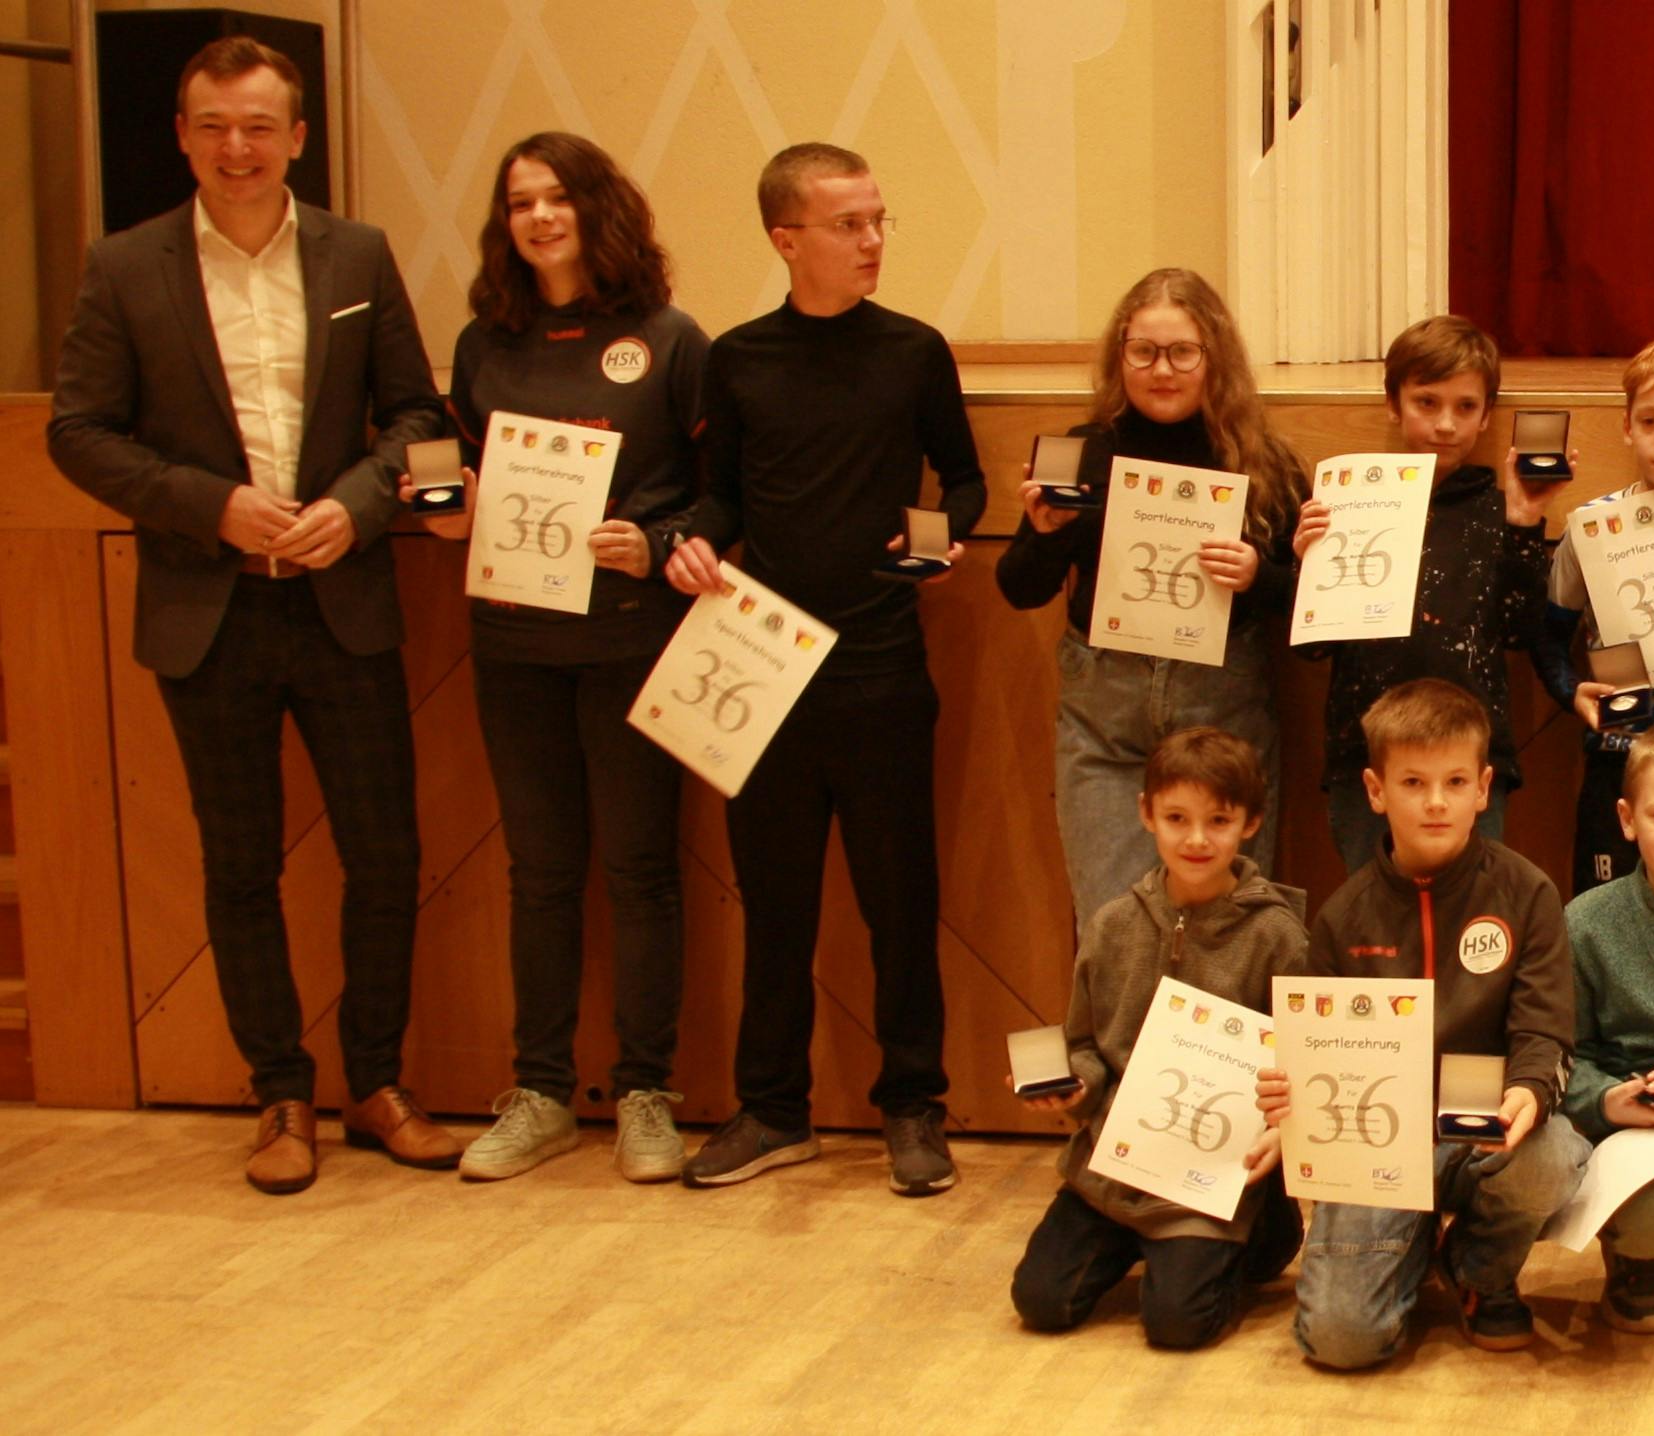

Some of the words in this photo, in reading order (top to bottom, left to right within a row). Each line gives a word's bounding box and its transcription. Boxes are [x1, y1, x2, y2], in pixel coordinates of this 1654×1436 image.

[605, 352, 642, 367] HSK
[507, 462, 585, 485] Sportlerehrung
[1133, 509, 1216, 533] Sportlerehrung
[1328, 499, 1402, 515] Sportlerehrung
[494, 492, 578, 559] 36
[1121, 542, 1206, 610] 36
[1315, 526, 1397, 591] 36
[671, 650, 769, 733] 36
[1463, 931, 1501, 957] HSK
[1171, 1032, 1258, 1076] Sportlerehrung
[1304, 1036, 1401, 1053] Sportlerehrung
[1338, 1072, 1367, 1082] Silber
[1137, 1067, 1246, 1153] 36
[1304, 1072, 1401, 1148] 36
